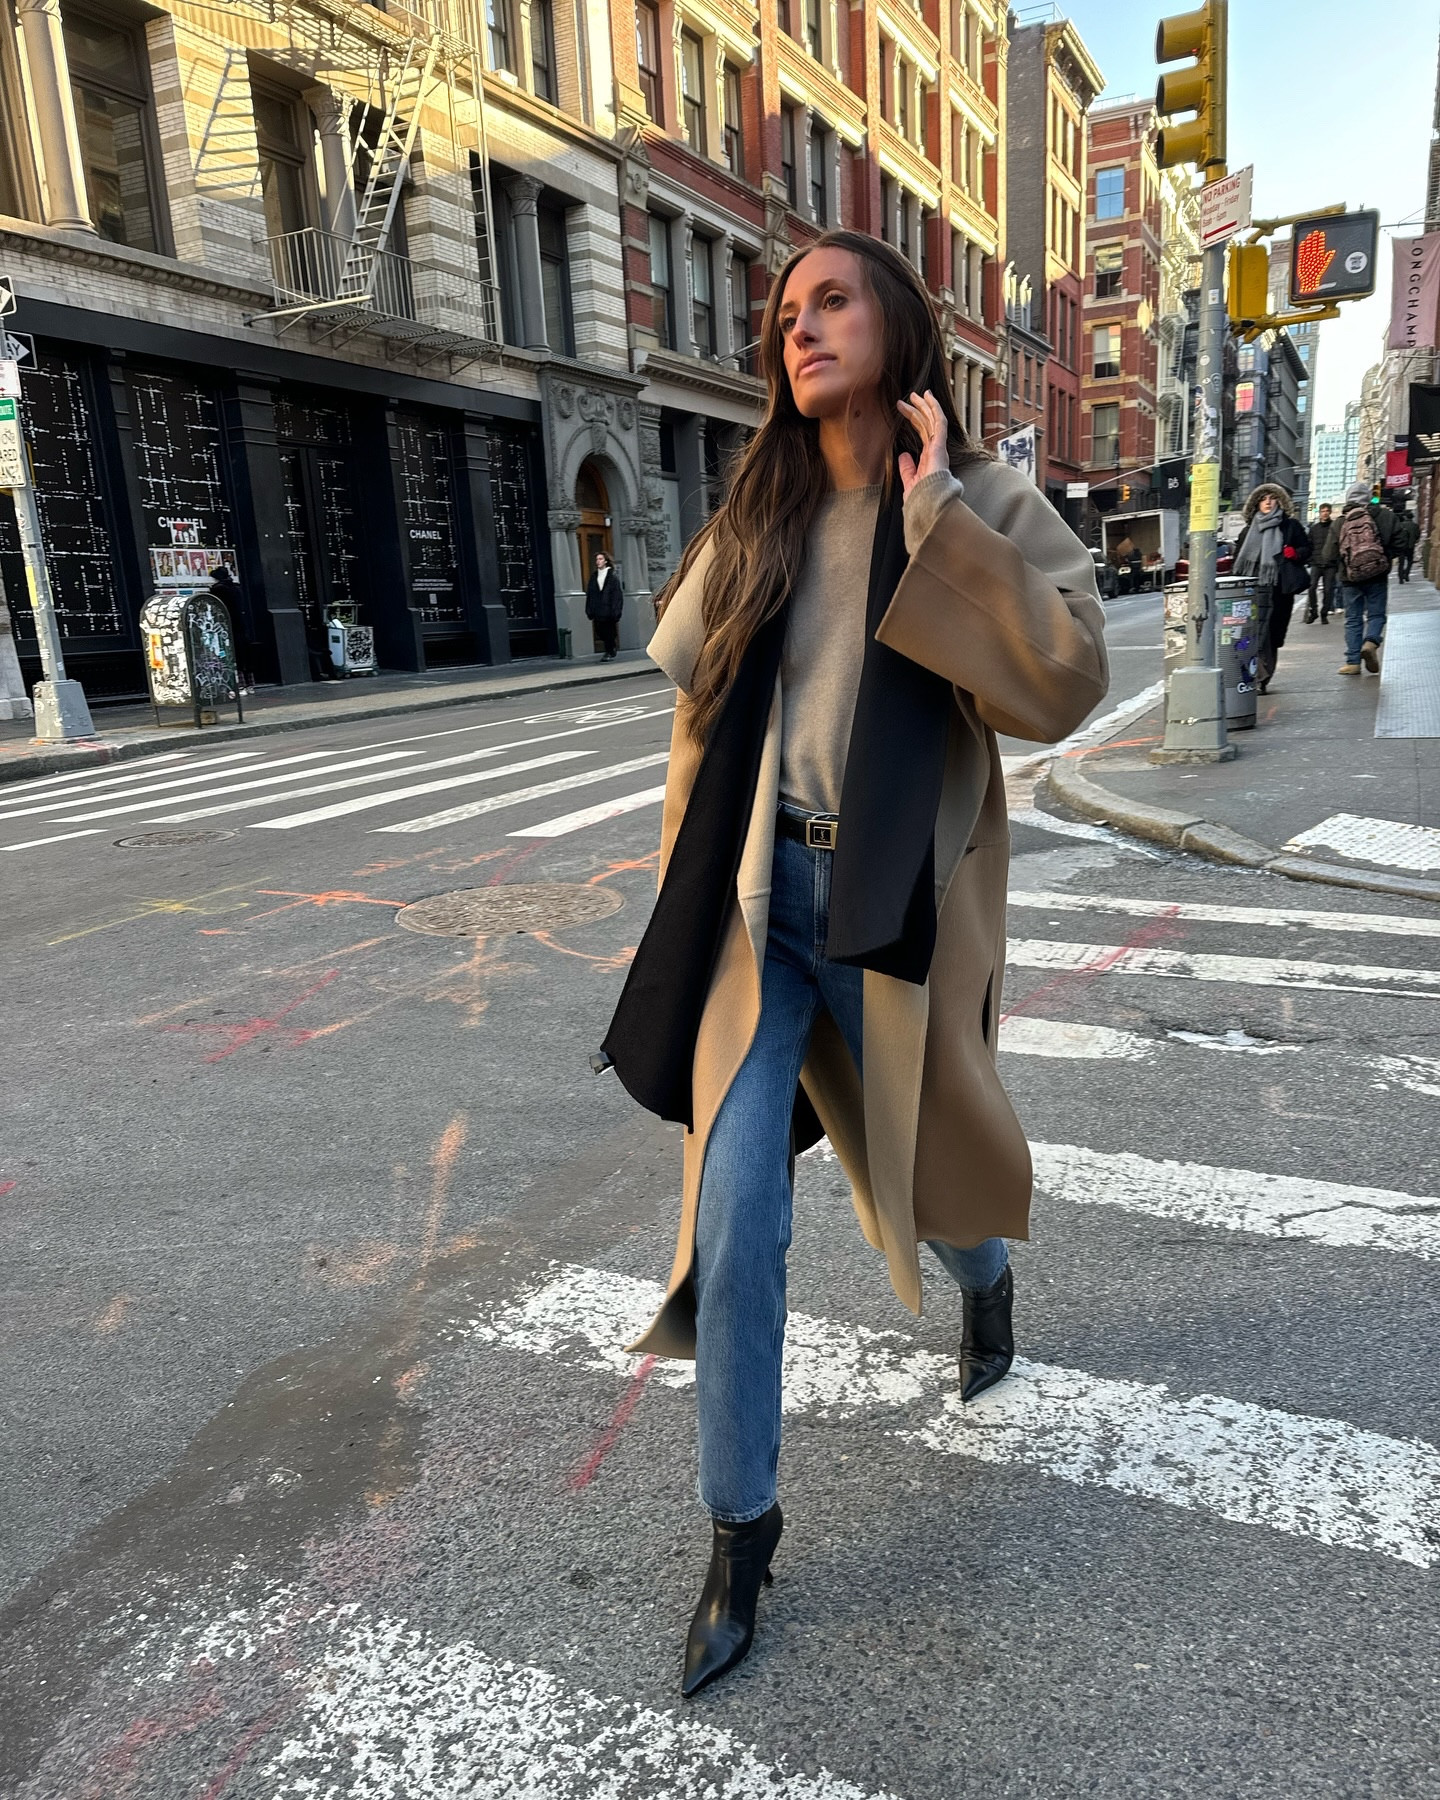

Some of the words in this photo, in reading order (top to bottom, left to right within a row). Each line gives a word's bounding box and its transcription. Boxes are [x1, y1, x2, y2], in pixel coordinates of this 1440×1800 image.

[1204, 190, 1212, 203] NO
[1213, 177, 1240, 198] PARKING
[1406, 237, 1424, 348] LONGCHAMP
[409, 529, 442, 539] CHANEL
